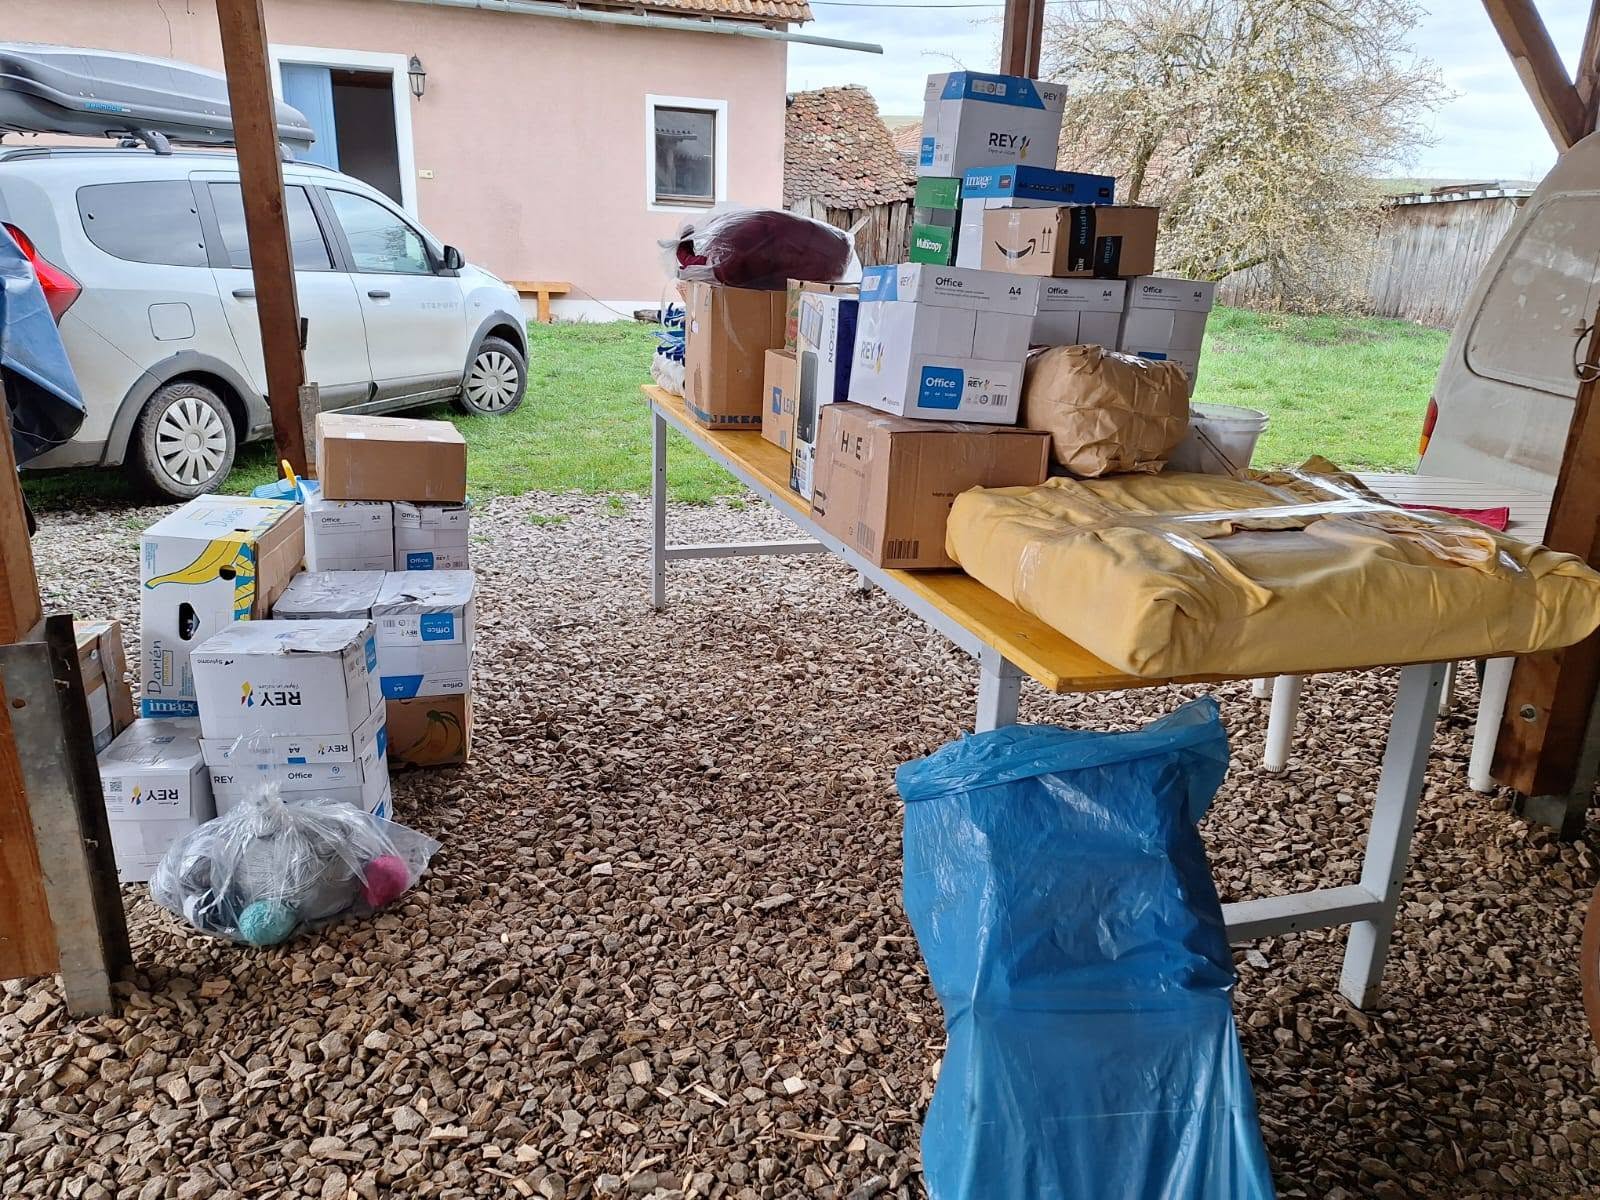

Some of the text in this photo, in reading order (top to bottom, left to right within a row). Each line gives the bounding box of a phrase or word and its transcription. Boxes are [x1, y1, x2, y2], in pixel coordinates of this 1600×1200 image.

[1043, 92, 1057, 101] REY
[988, 132, 1018, 148] REY
[965, 174, 992, 189] image
[916, 237, 943, 253] Multicopy
[935, 277, 963, 288] Office
[1008, 286, 1022, 296] A4
[1047, 287, 1069, 295] Office
[1143, 286, 1162, 294] Office
[828, 307, 836, 363] EPSON
[861, 341, 876, 361] REY
[926, 377, 956, 389] Office
[968, 380, 982, 388] REY
[720, 415, 762, 424] IKEA
[146, 640, 161, 694] Darién
[260, 691, 302, 706] REY
[327, 744, 348, 753] REY
[213, 776, 234, 784] REY
[287, 772, 313, 780] Office
[146, 789, 179, 801] REY
